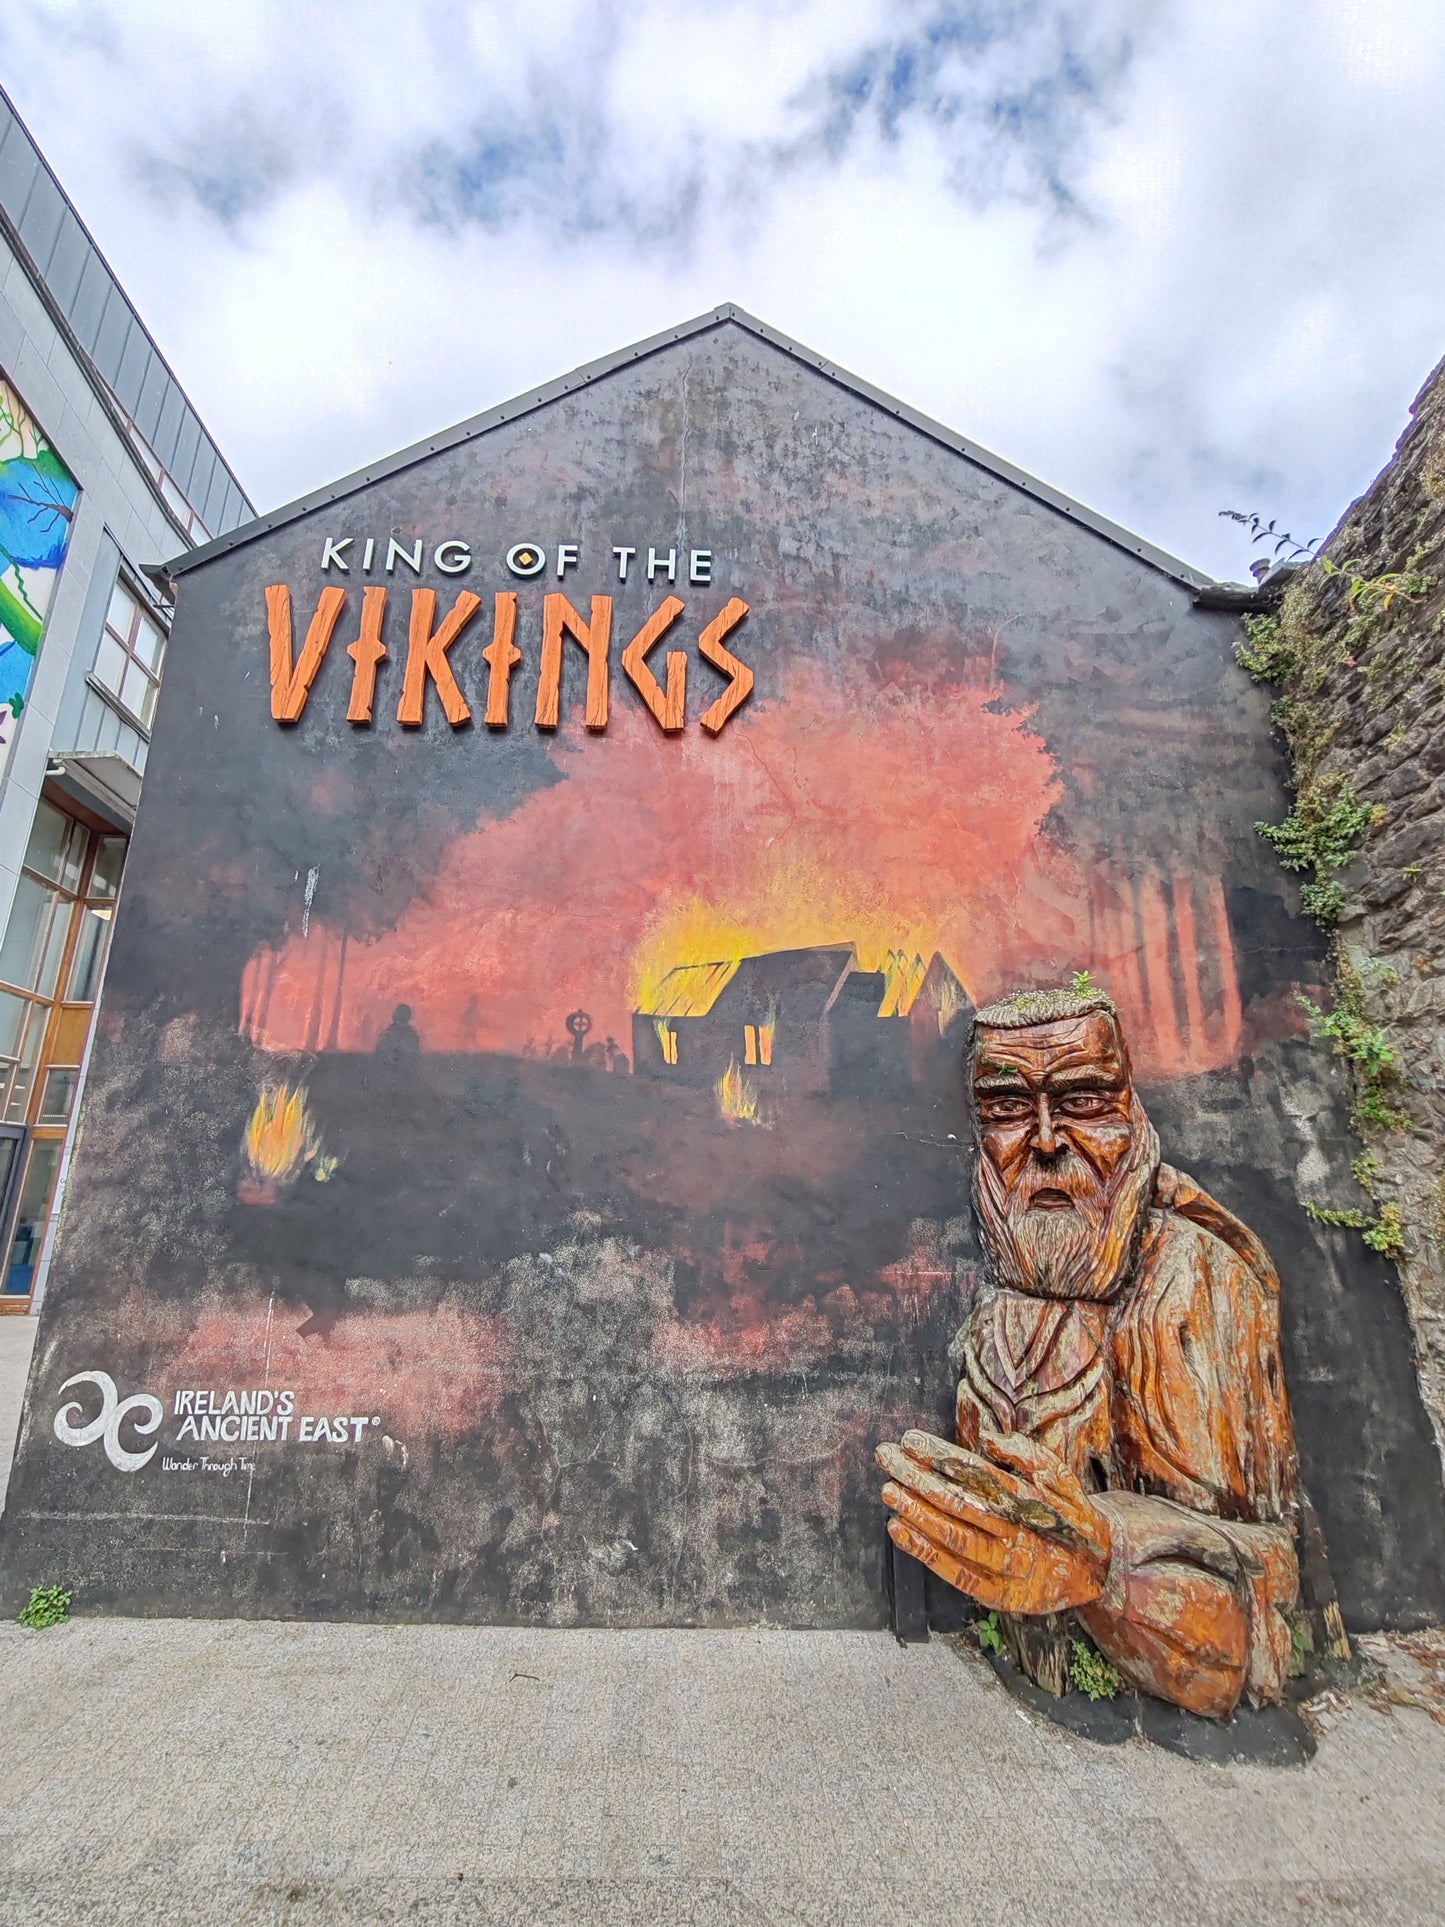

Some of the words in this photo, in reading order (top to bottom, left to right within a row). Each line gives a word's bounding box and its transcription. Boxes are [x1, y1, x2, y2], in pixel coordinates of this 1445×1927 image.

[320, 537, 472, 576] KING
[506, 543, 579, 577] OF
[613, 547, 712, 583] THE
[265, 584, 754, 736] VIKINGS
[174, 1391, 295, 1415] IRELAND'S
[176, 1416, 294, 1441] ANCIENT
[162, 1457, 199, 1471] Wander
[200, 1456, 238, 1477] Through
